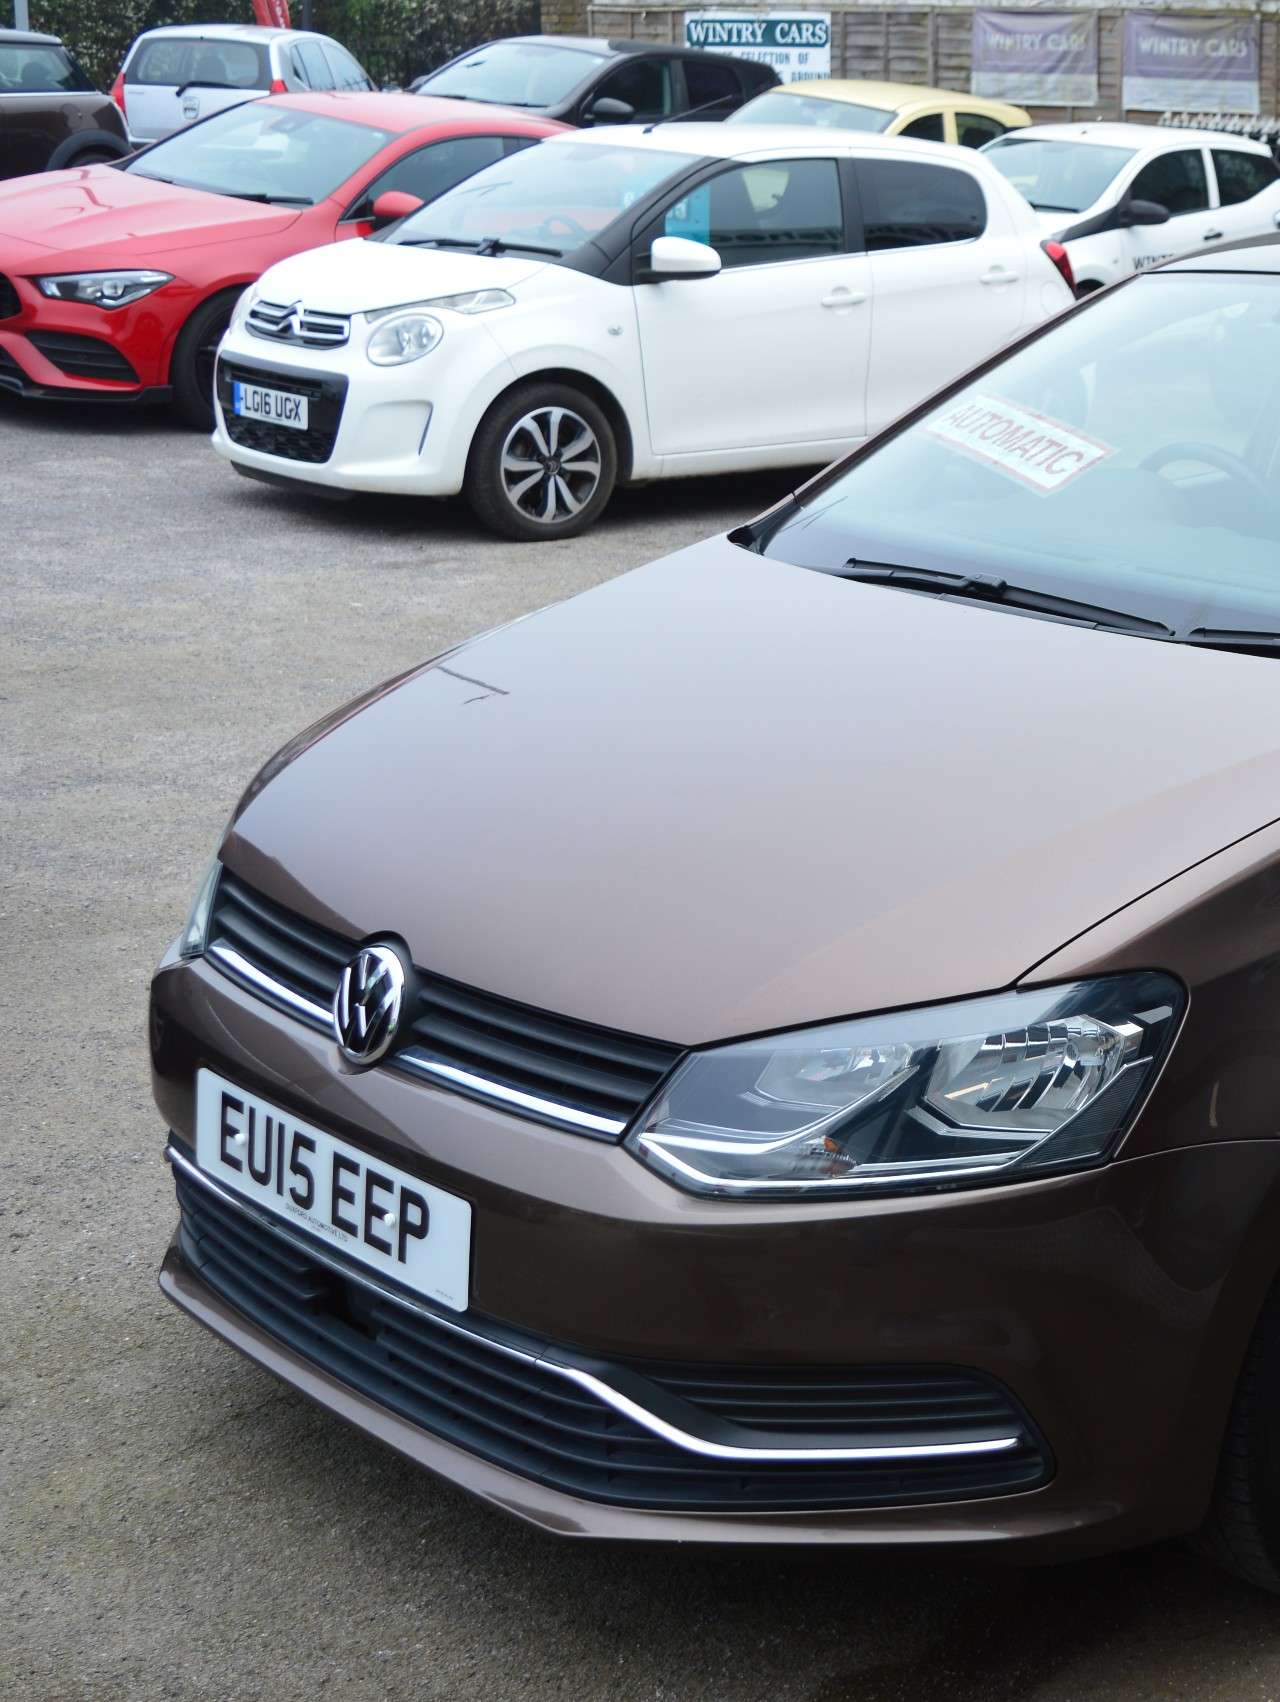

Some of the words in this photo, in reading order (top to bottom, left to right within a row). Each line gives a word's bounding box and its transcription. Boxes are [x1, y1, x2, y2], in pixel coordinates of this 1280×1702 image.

[689, 22, 767, 43] WINTRY
[775, 22, 827, 44] CARS
[988, 33, 1041, 50] WINTRY
[1046, 34, 1086, 51] CARS
[798, 52, 810, 64] OF
[1139, 37, 1198, 56] WINTRY
[1204, 39, 1248, 57] CARS
[245, 388, 271, 415] LG16
[275, 395, 302, 423] UGX
[942, 404, 1084, 475] AUTOMATIC
[220, 1091, 317, 1211] EU15
[331, 1151, 430, 1265] EEP
